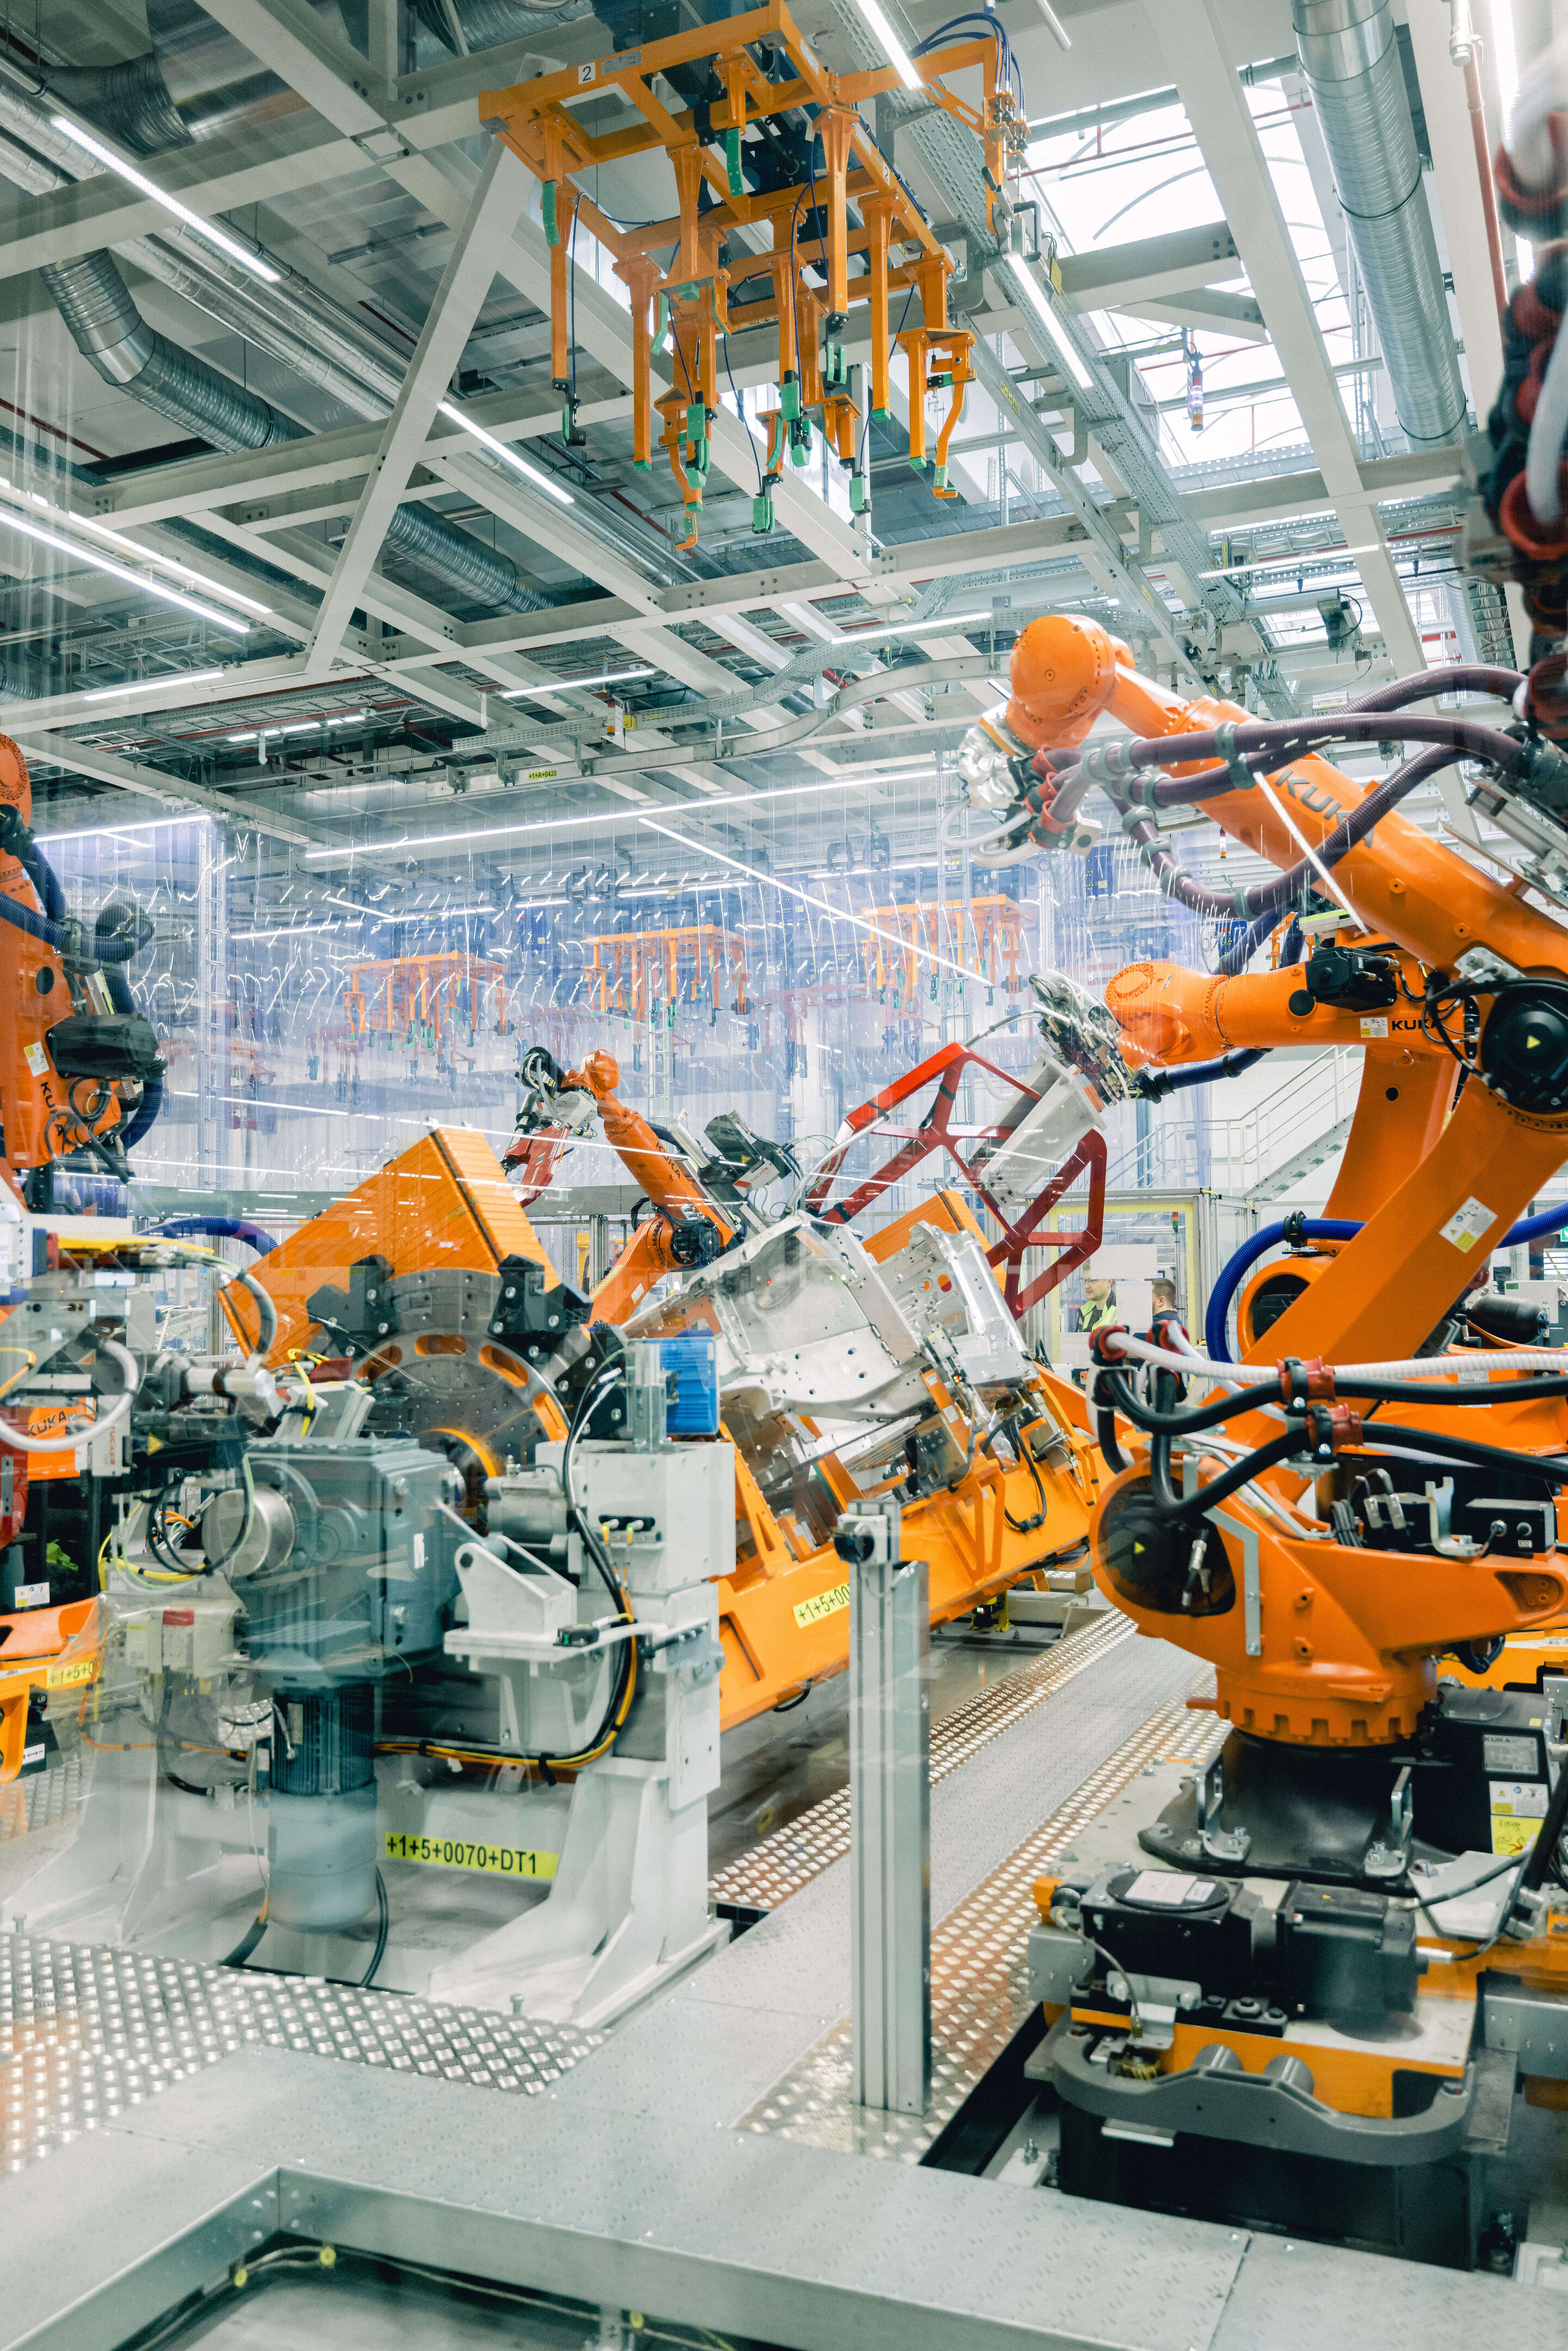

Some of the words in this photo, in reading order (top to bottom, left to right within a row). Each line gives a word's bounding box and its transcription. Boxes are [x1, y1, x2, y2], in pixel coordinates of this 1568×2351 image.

[583, 66, 591, 82] 2
[885, 167, 889, 183] 2
[529, 770, 557, 779] +1+A+0420
[656, 1142, 681, 1179] KUKA
[799, 1582, 849, 1620] +1+5+00
[387, 1835, 535, 1874] +1+5+0070+DT1
